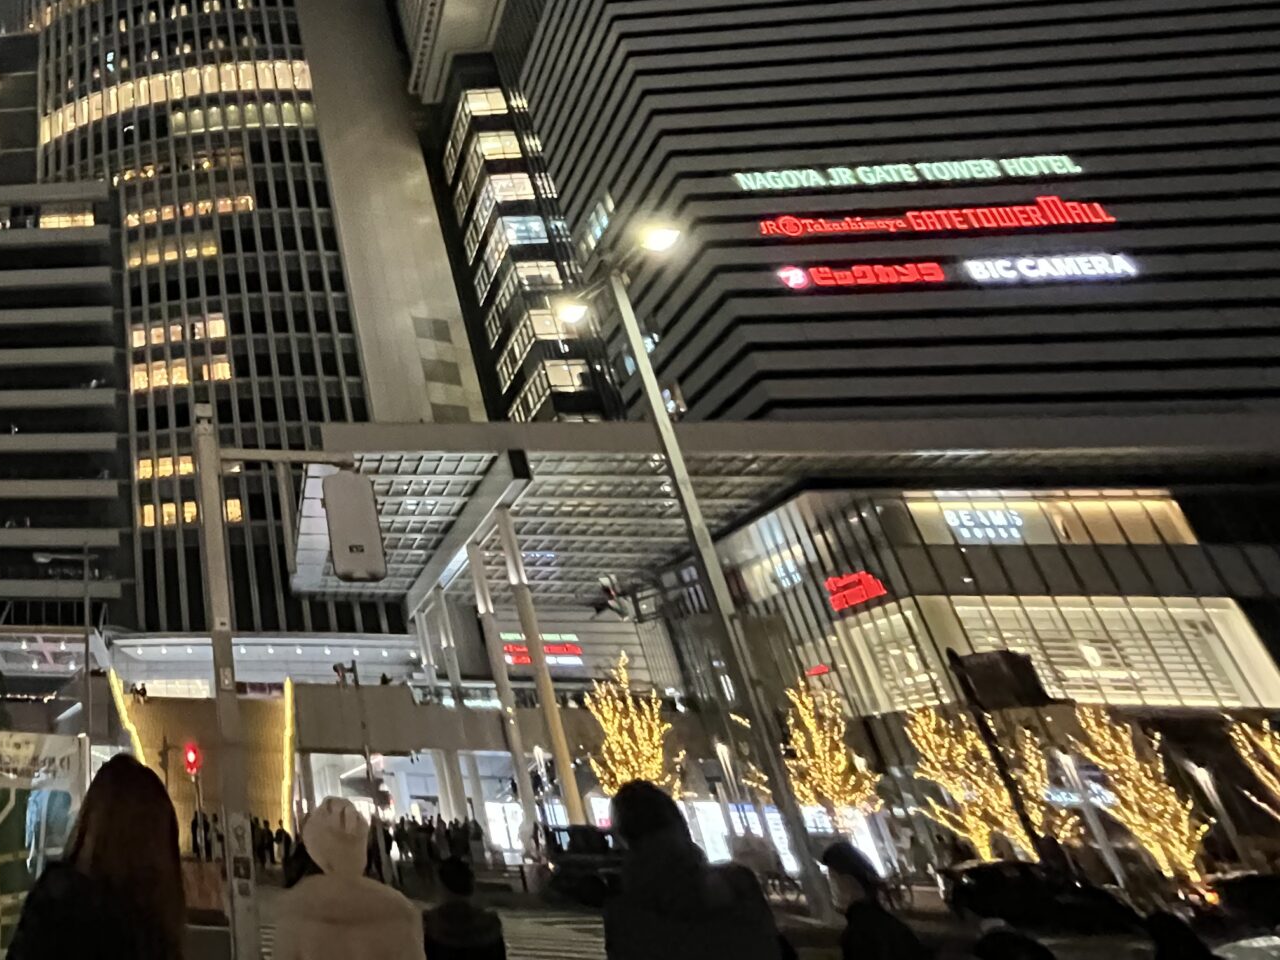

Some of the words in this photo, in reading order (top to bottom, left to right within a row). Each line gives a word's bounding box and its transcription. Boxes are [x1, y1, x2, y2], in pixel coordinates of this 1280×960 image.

[734, 169, 827, 190] NAGOYA
[827, 167, 858, 186] JR
[856, 163, 919, 185] GATE
[915, 159, 1002, 181] TOWER
[999, 155, 1083, 176] HOTEL
[801, 216, 907, 233] Takashimaya
[808, 262, 945, 286] ビックカメラ
[964, 258, 1018, 280] BIC
[1017, 253, 1137, 277] CAMERA
